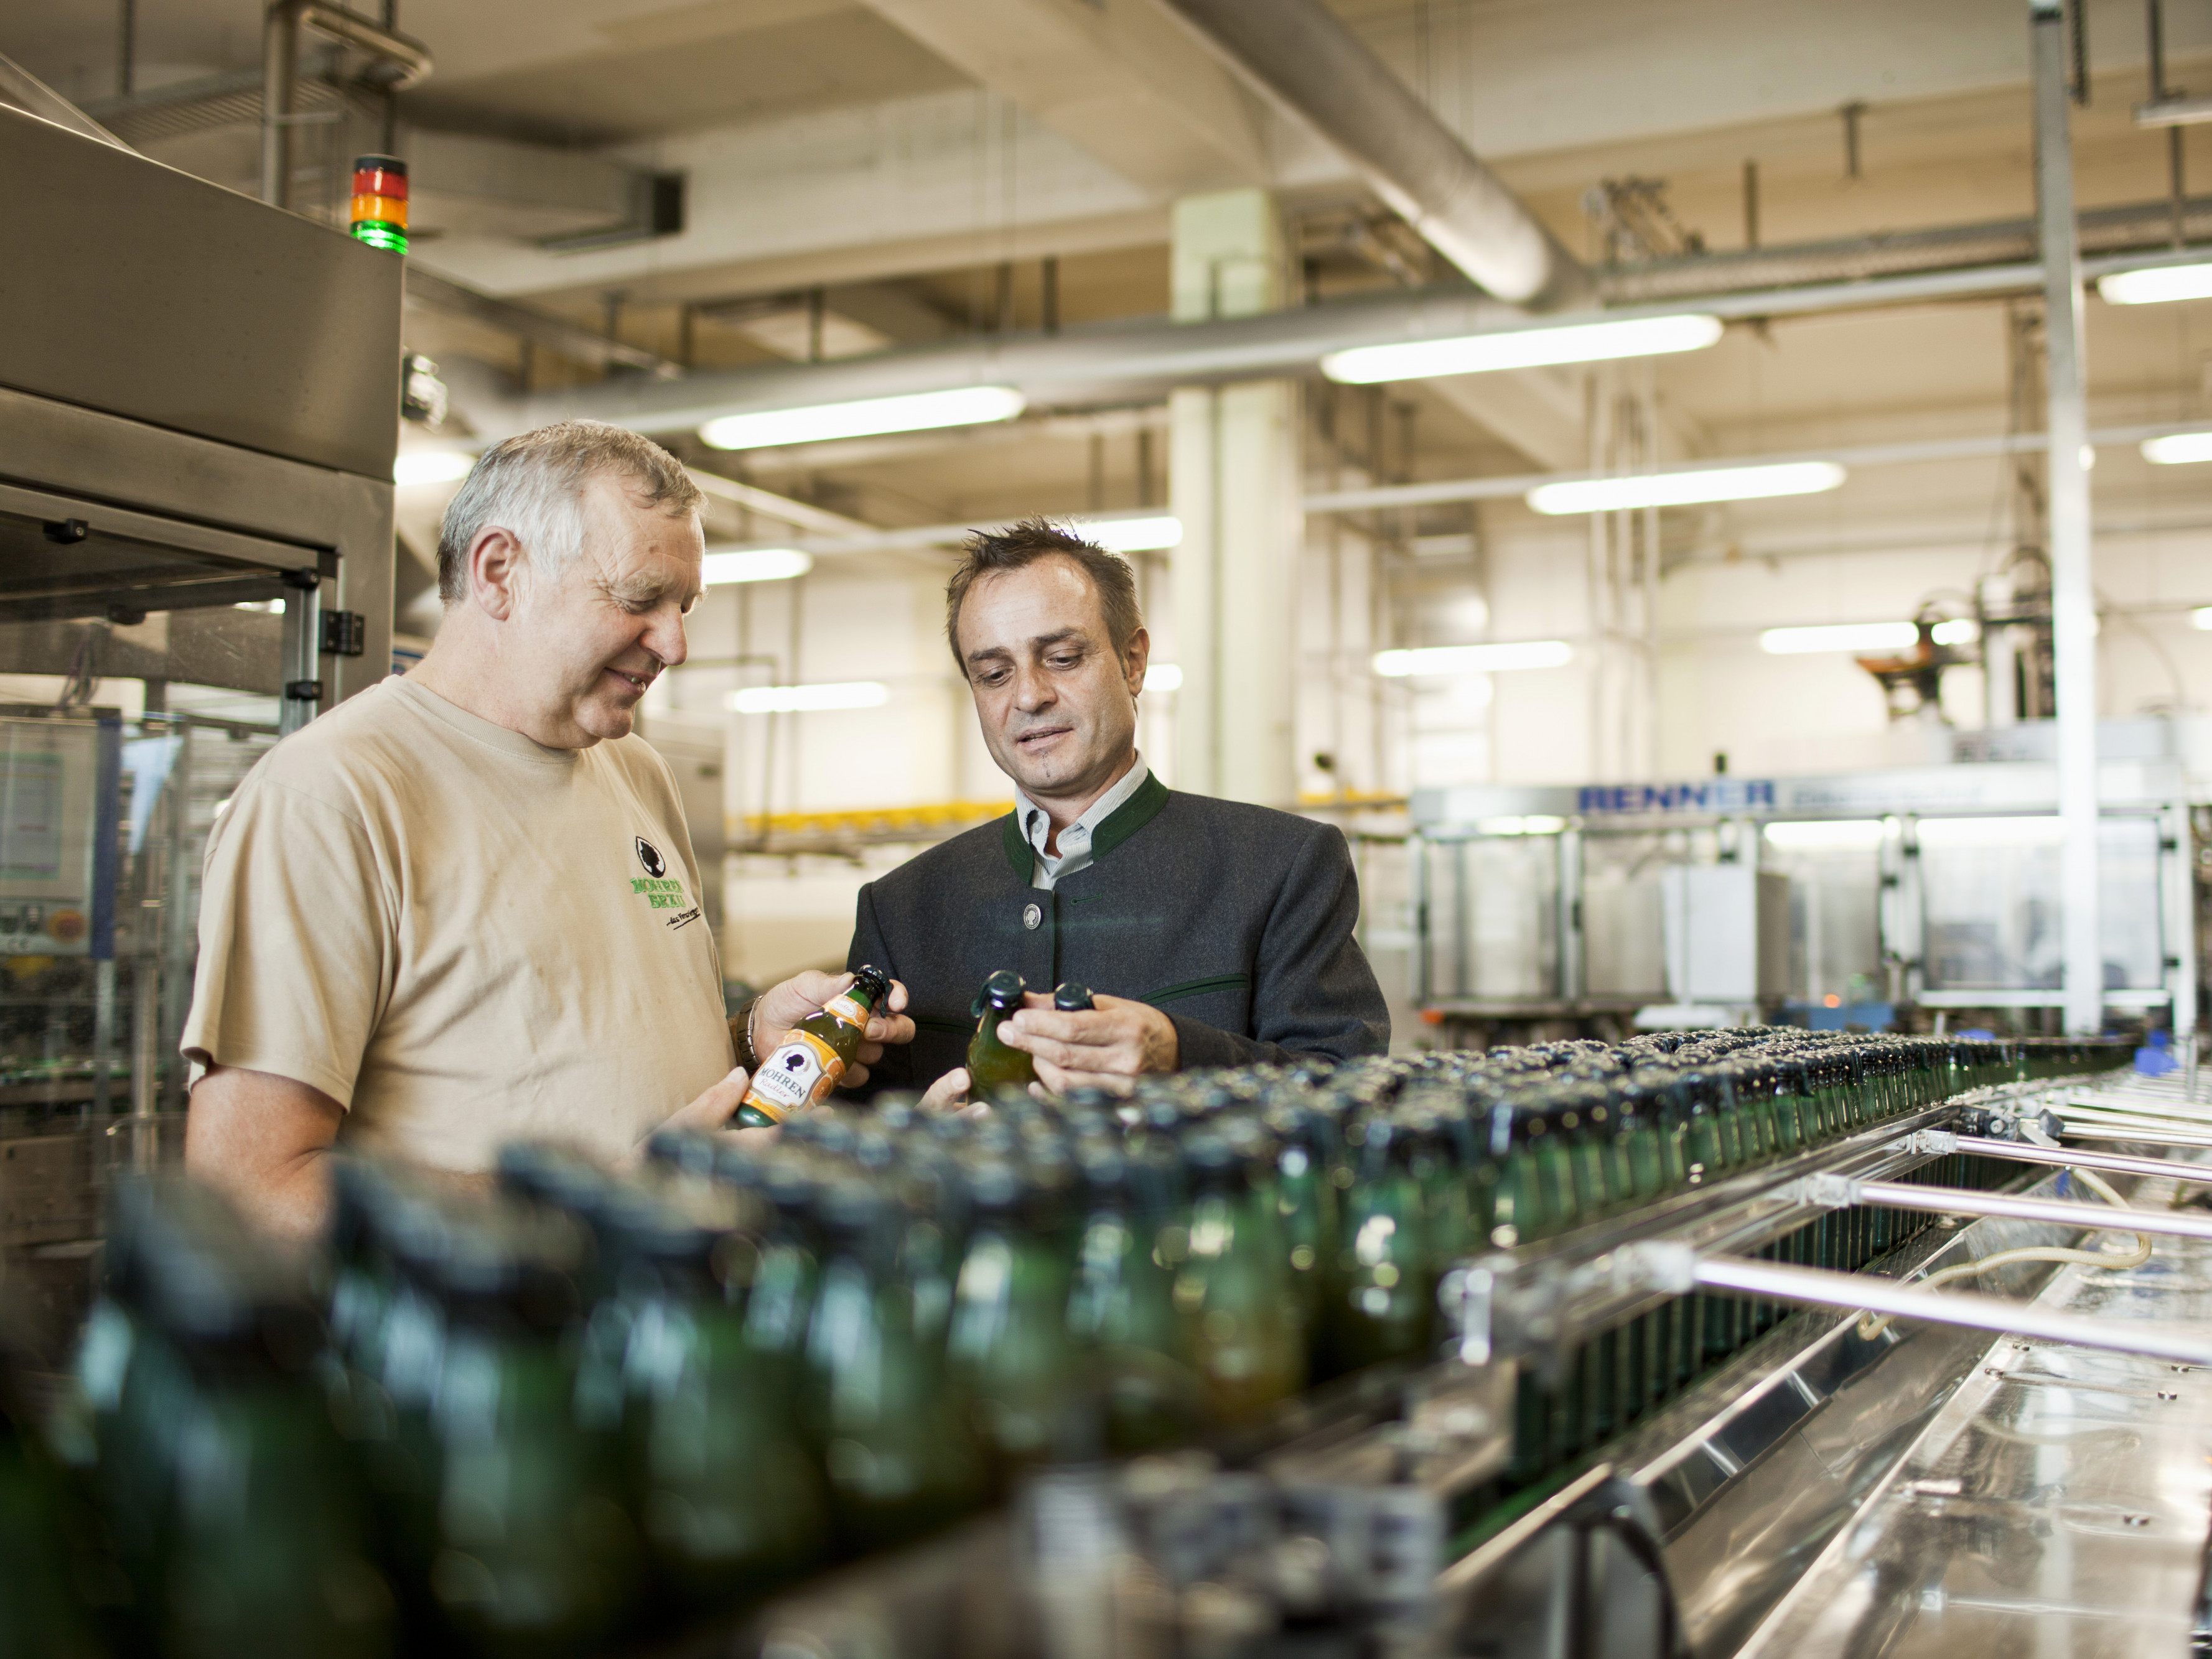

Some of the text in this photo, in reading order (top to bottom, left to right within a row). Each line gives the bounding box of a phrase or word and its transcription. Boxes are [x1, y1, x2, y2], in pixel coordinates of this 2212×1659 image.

[1579, 781, 1775, 813] RENNER
[759, 1067, 806, 1099] MOHREN
[760, 1078, 790, 1098] Radler
